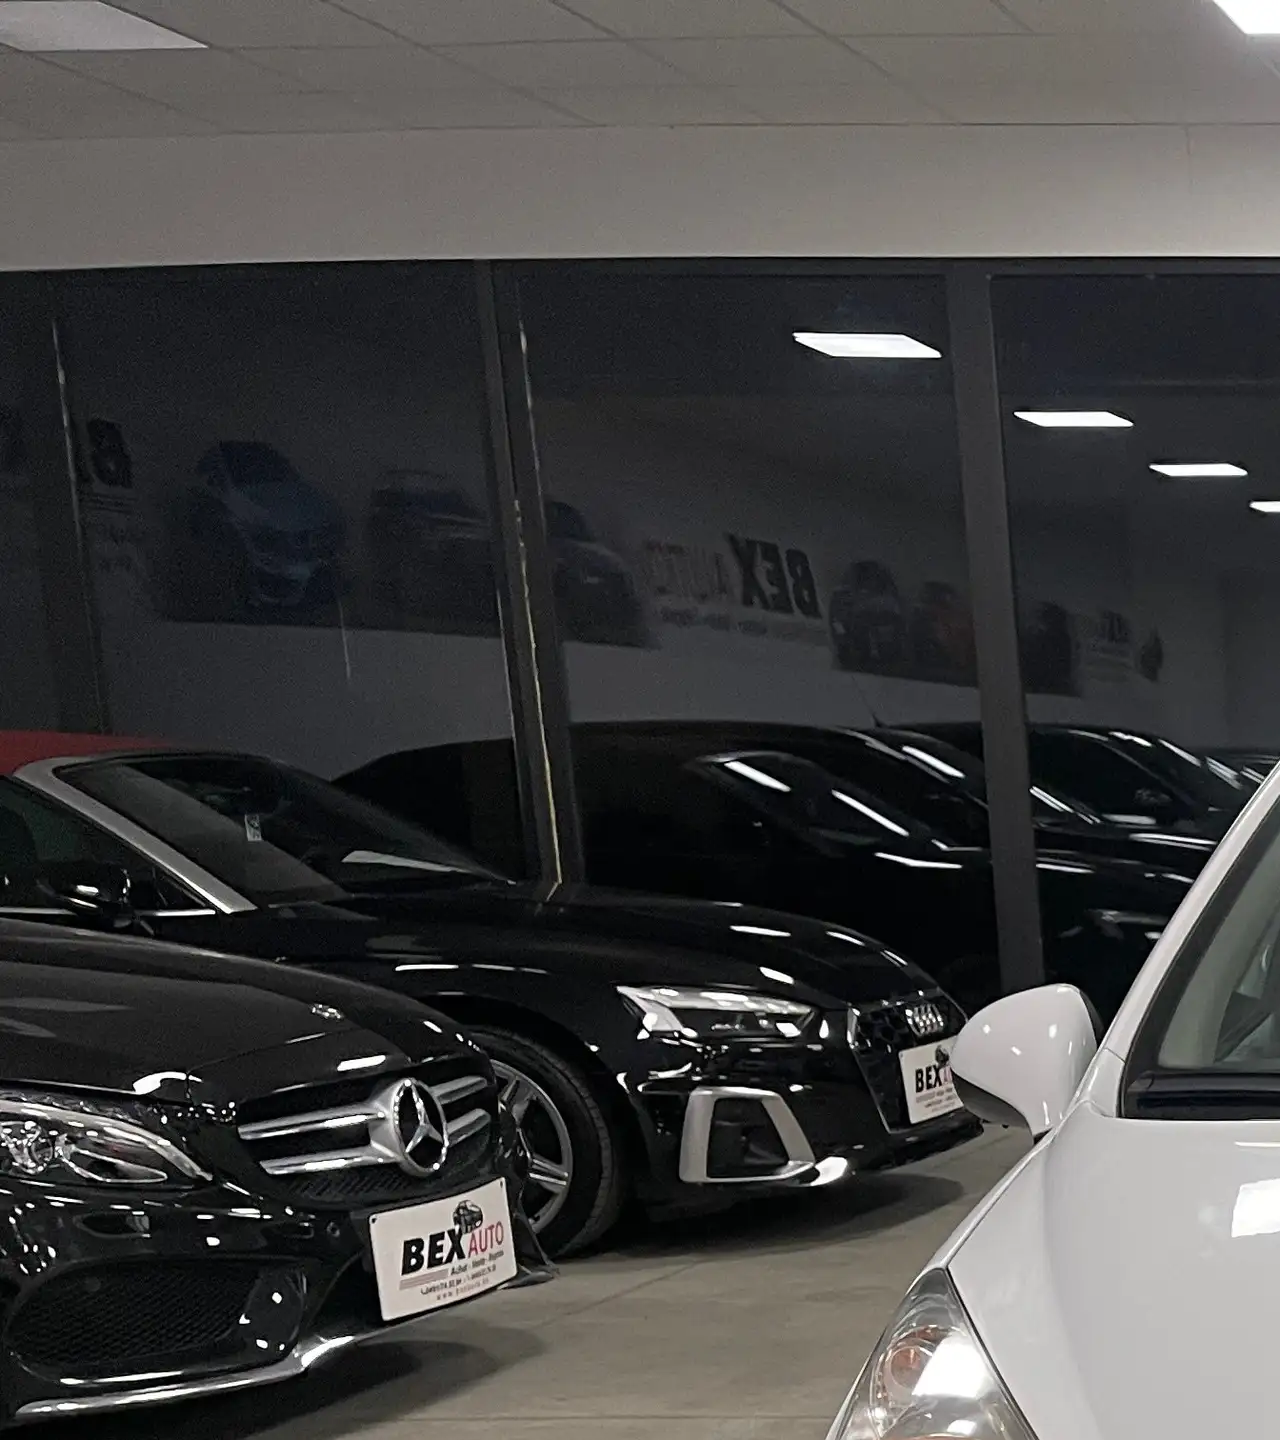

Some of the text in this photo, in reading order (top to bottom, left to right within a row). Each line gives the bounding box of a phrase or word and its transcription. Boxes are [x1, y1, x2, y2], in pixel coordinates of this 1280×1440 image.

[915, 1065, 943, 1093] BEX
[401, 1228, 466, 1276] BEX
[468, 1221, 504, 1258] AUTO
